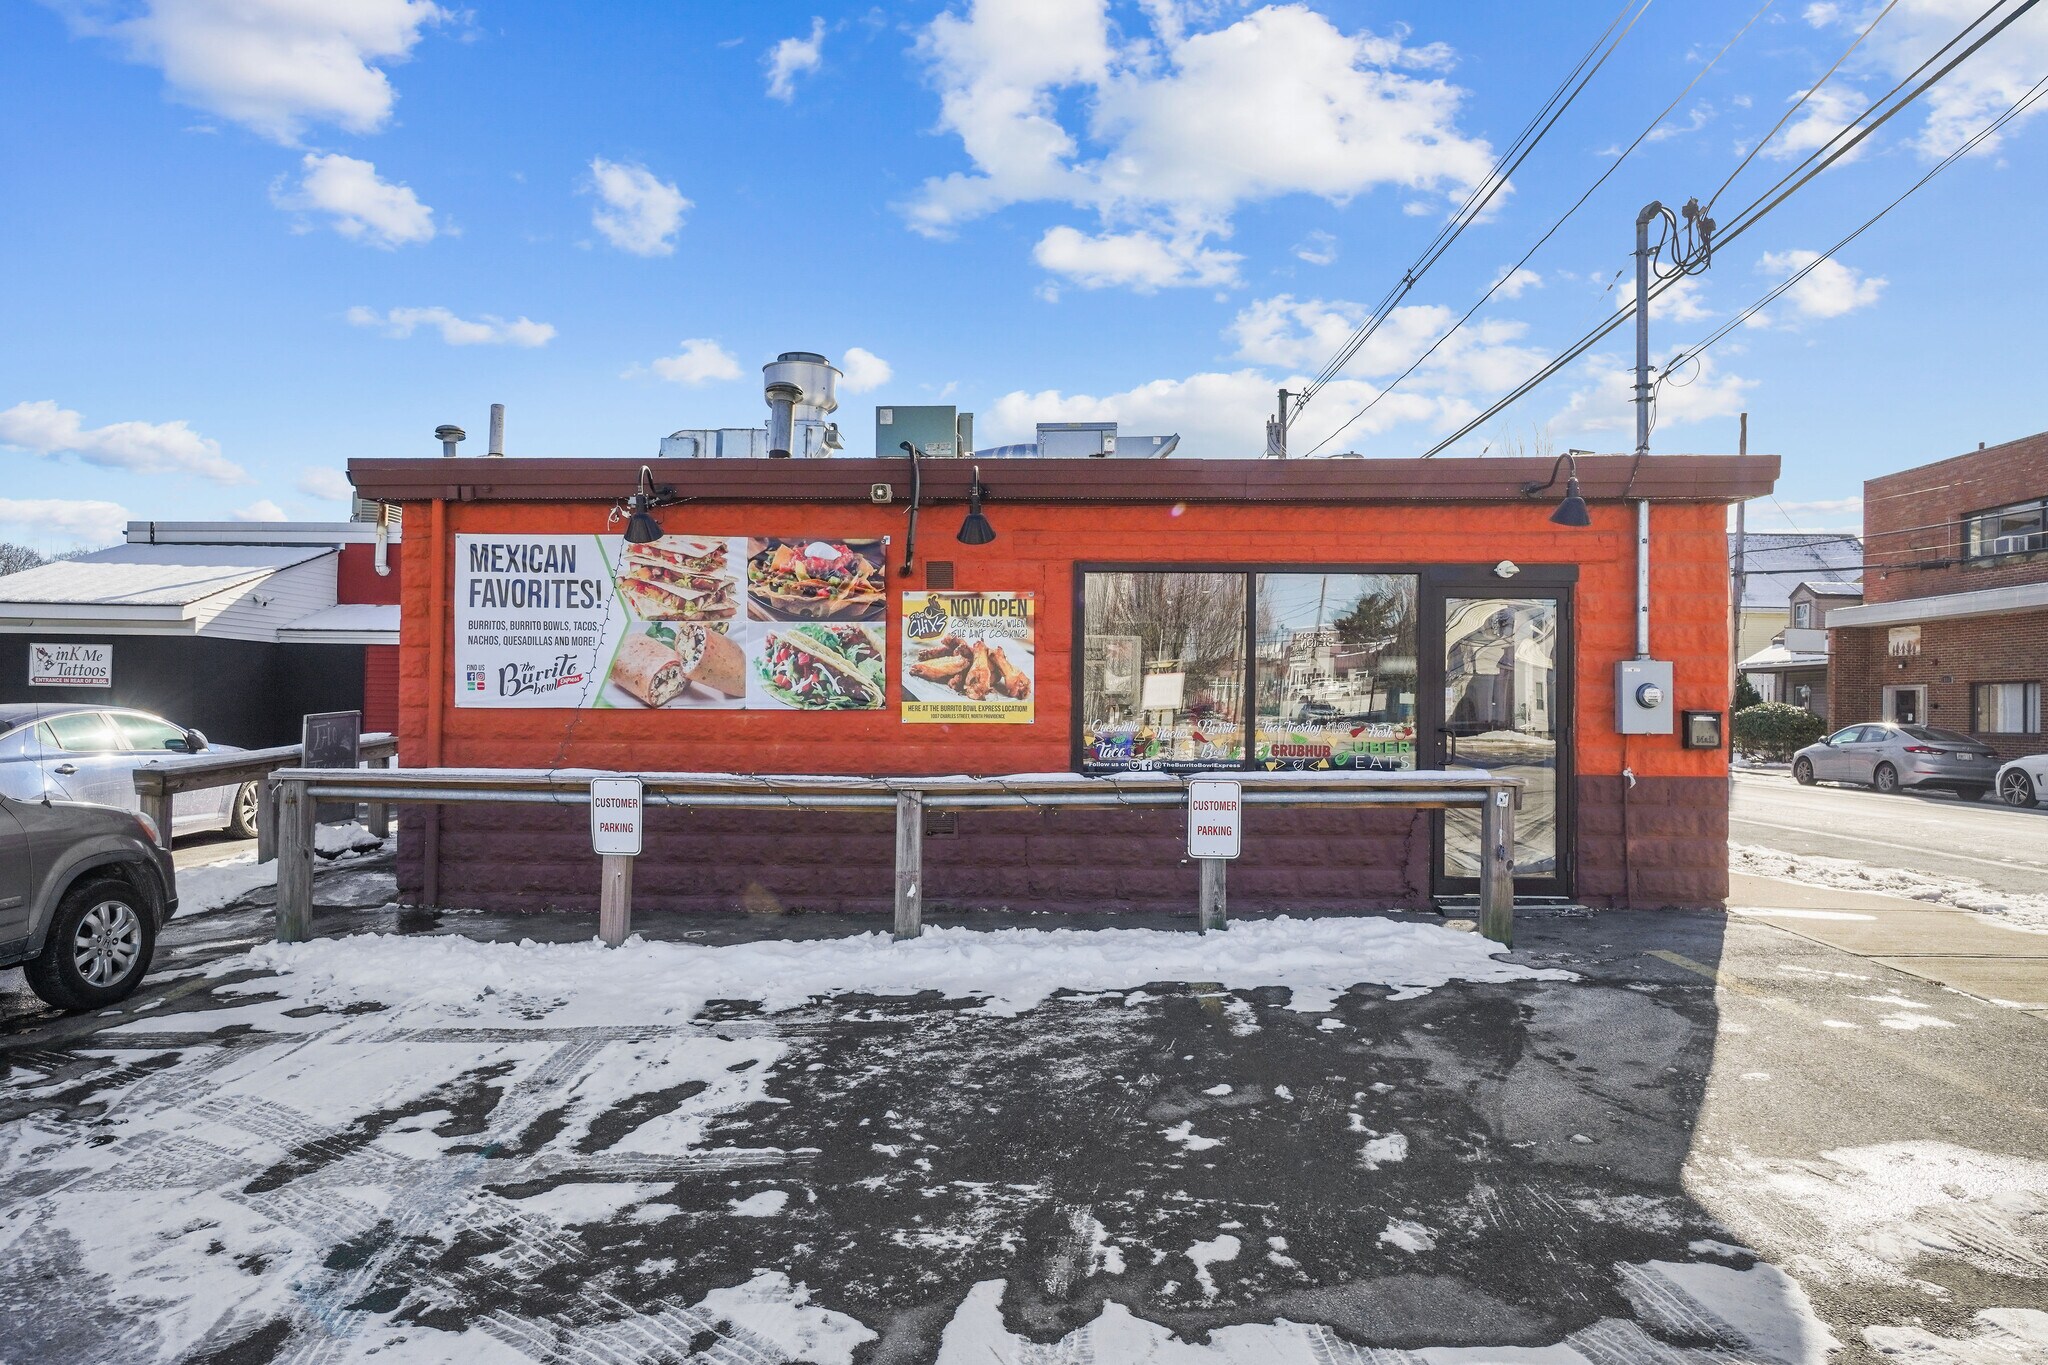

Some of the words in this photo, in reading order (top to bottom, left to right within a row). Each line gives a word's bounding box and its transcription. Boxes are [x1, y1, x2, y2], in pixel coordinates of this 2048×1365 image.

[470, 544, 576, 573] MEXICAN
[469, 579, 602, 609] FAVORITES!
[951, 598, 984, 617] NOW
[989, 598, 1027, 617] OPEN
[468, 620, 508, 631] BURRITOS,
[510, 620, 542, 631] BURRITO
[543, 621, 571, 632] BOWLS,
[573, 621, 599, 632] TACOS,
[951, 619, 973, 628] COME
[976, 619, 988, 628] SEE
[1006, 619, 1026, 628] WHEN
[989, 629, 1028, 638] COOKING!
[468, 635, 500, 646] NACHOS,
[503, 636, 552, 646] QUESADILLAS
[554, 636, 570, 646] AND
[571, 636, 595, 646] MORE!
[82, 649, 103, 661] Me
[57, 662, 107, 676] Tattoos
[1091, 719, 1140, 734] Quesadilla
[1198, 719, 1238, 735] Burrito
[1261, 721, 1283, 733] Taco
[1284, 720, 1322, 736] Tuesday
[1367, 723, 1395, 738] Fresh
[1096, 743, 1125, 758] Taco
[1271, 744, 1331, 758] GRUBHUB
[1353, 741, 1410, 754] UBER
[1153, 761, 1241, 769] @TheBurritoBowlExpress
[1355, 755, 1410, 769] EATS
[595, 797, 638, 808] CUSTOMER
[1193, 800, 1237, 811] CUSTOMER
[600, 822, 634, 833] PARKING
[1197, 826, 1232, 836] PARKING
